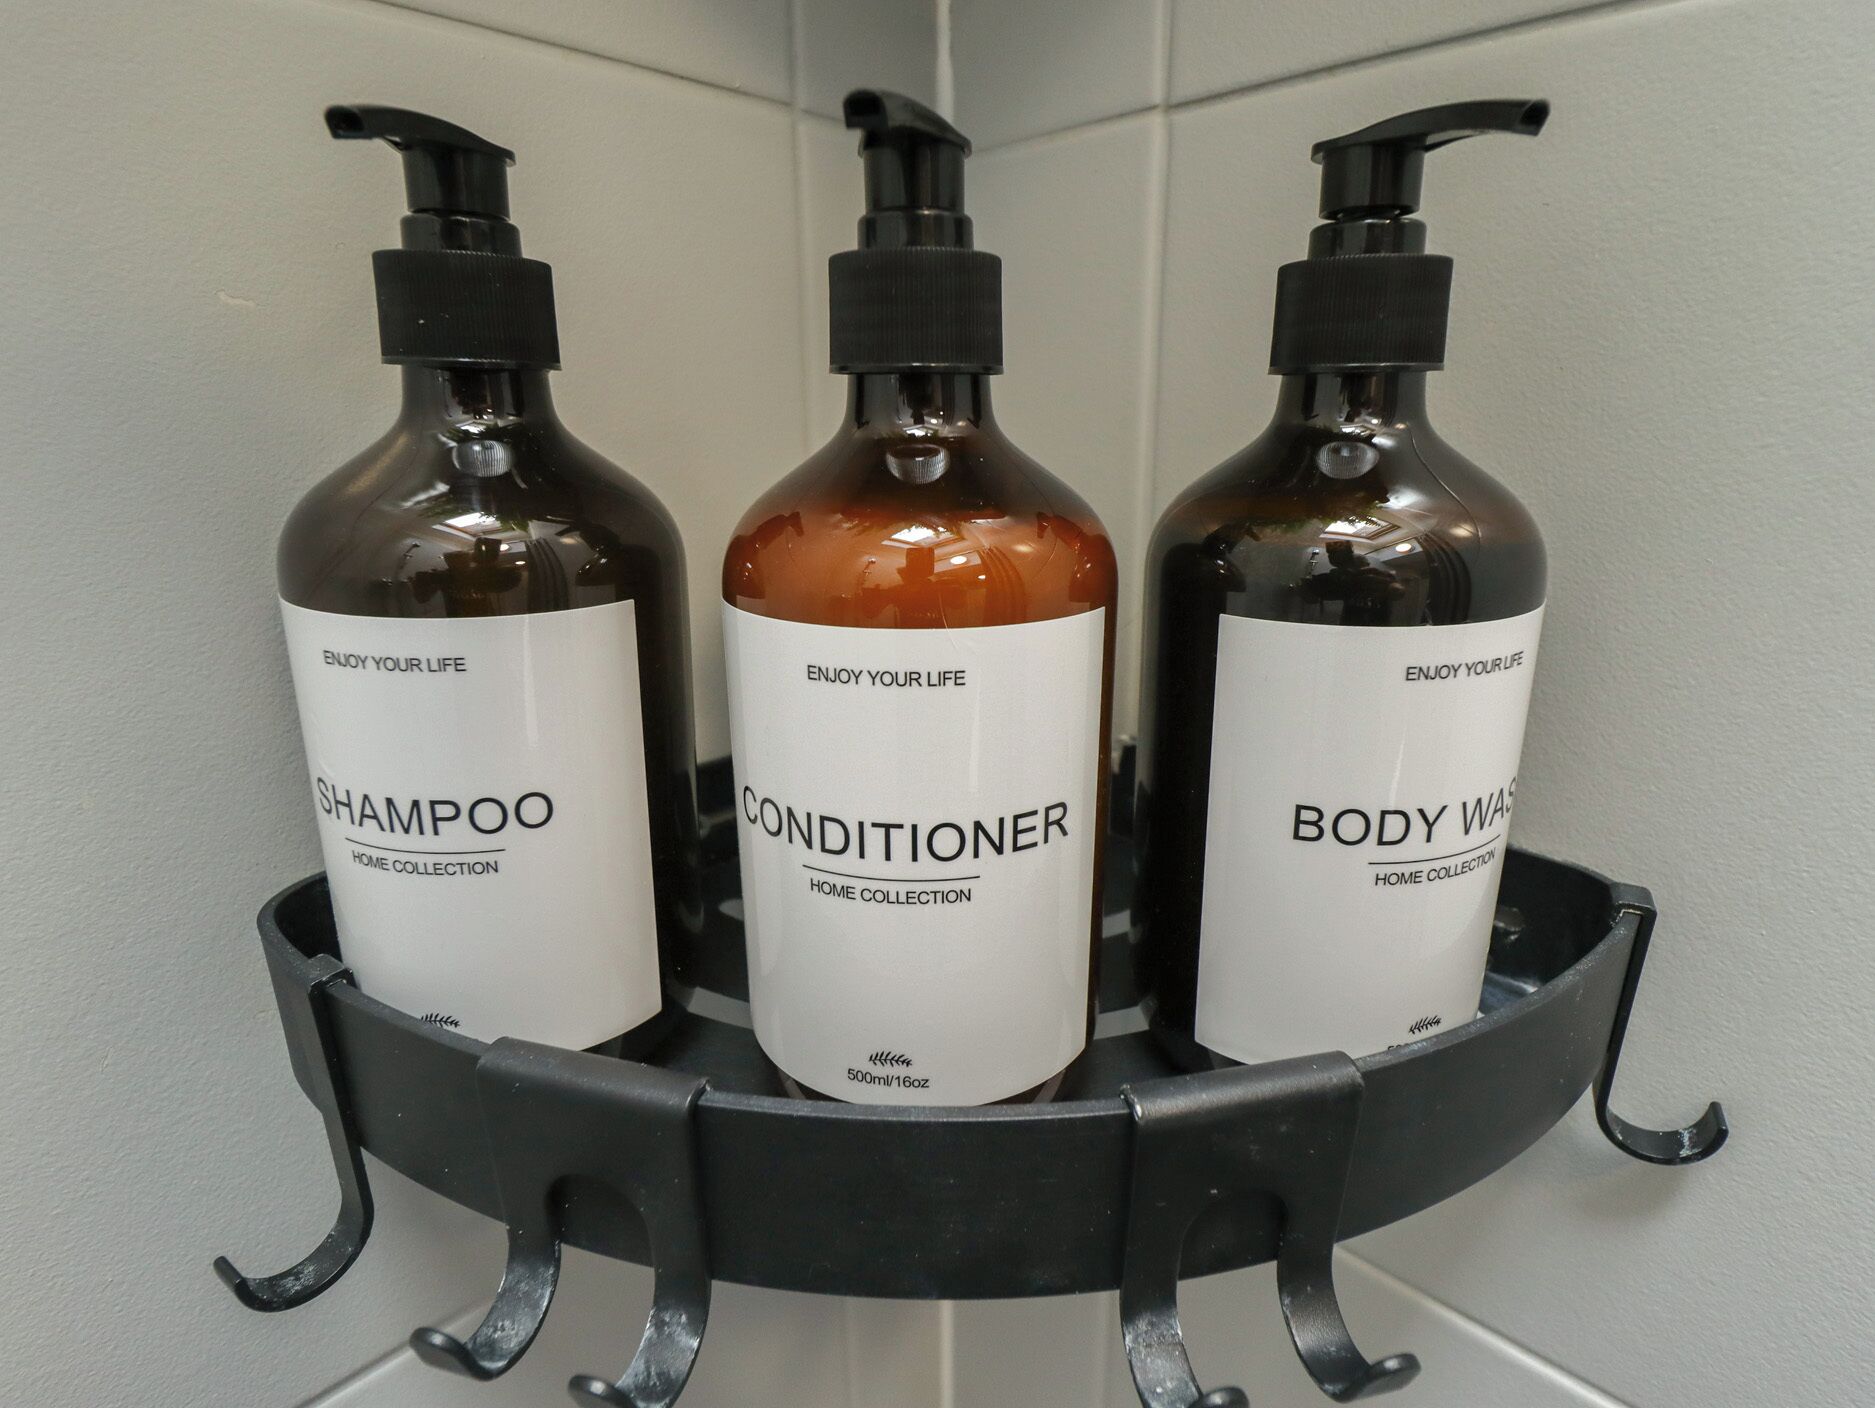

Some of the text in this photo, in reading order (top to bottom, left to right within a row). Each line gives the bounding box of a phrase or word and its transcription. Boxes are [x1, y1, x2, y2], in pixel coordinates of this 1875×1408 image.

[322, 650, 467, 673] ENJOY YOUR LIFE
[806, 664, 967, 688] ENJOY YOUR LIFE
[1405, 650, 1524, 682] ENJOY YOUR LIFE
[316, 776, 554, 837] SHAMPOO
[743, 785, 1069, 863] CONDITIONER
[1292, 803, 1449, 847] BODY
[352, 850, 499, 877] HOME COLLECTION
[1374, 847, 1497, 887] HOME COLLECTION
[809, 877, 972, 906] HOME COLLECTION
[847, 1067, 930, 1089] 500ml/16oz
